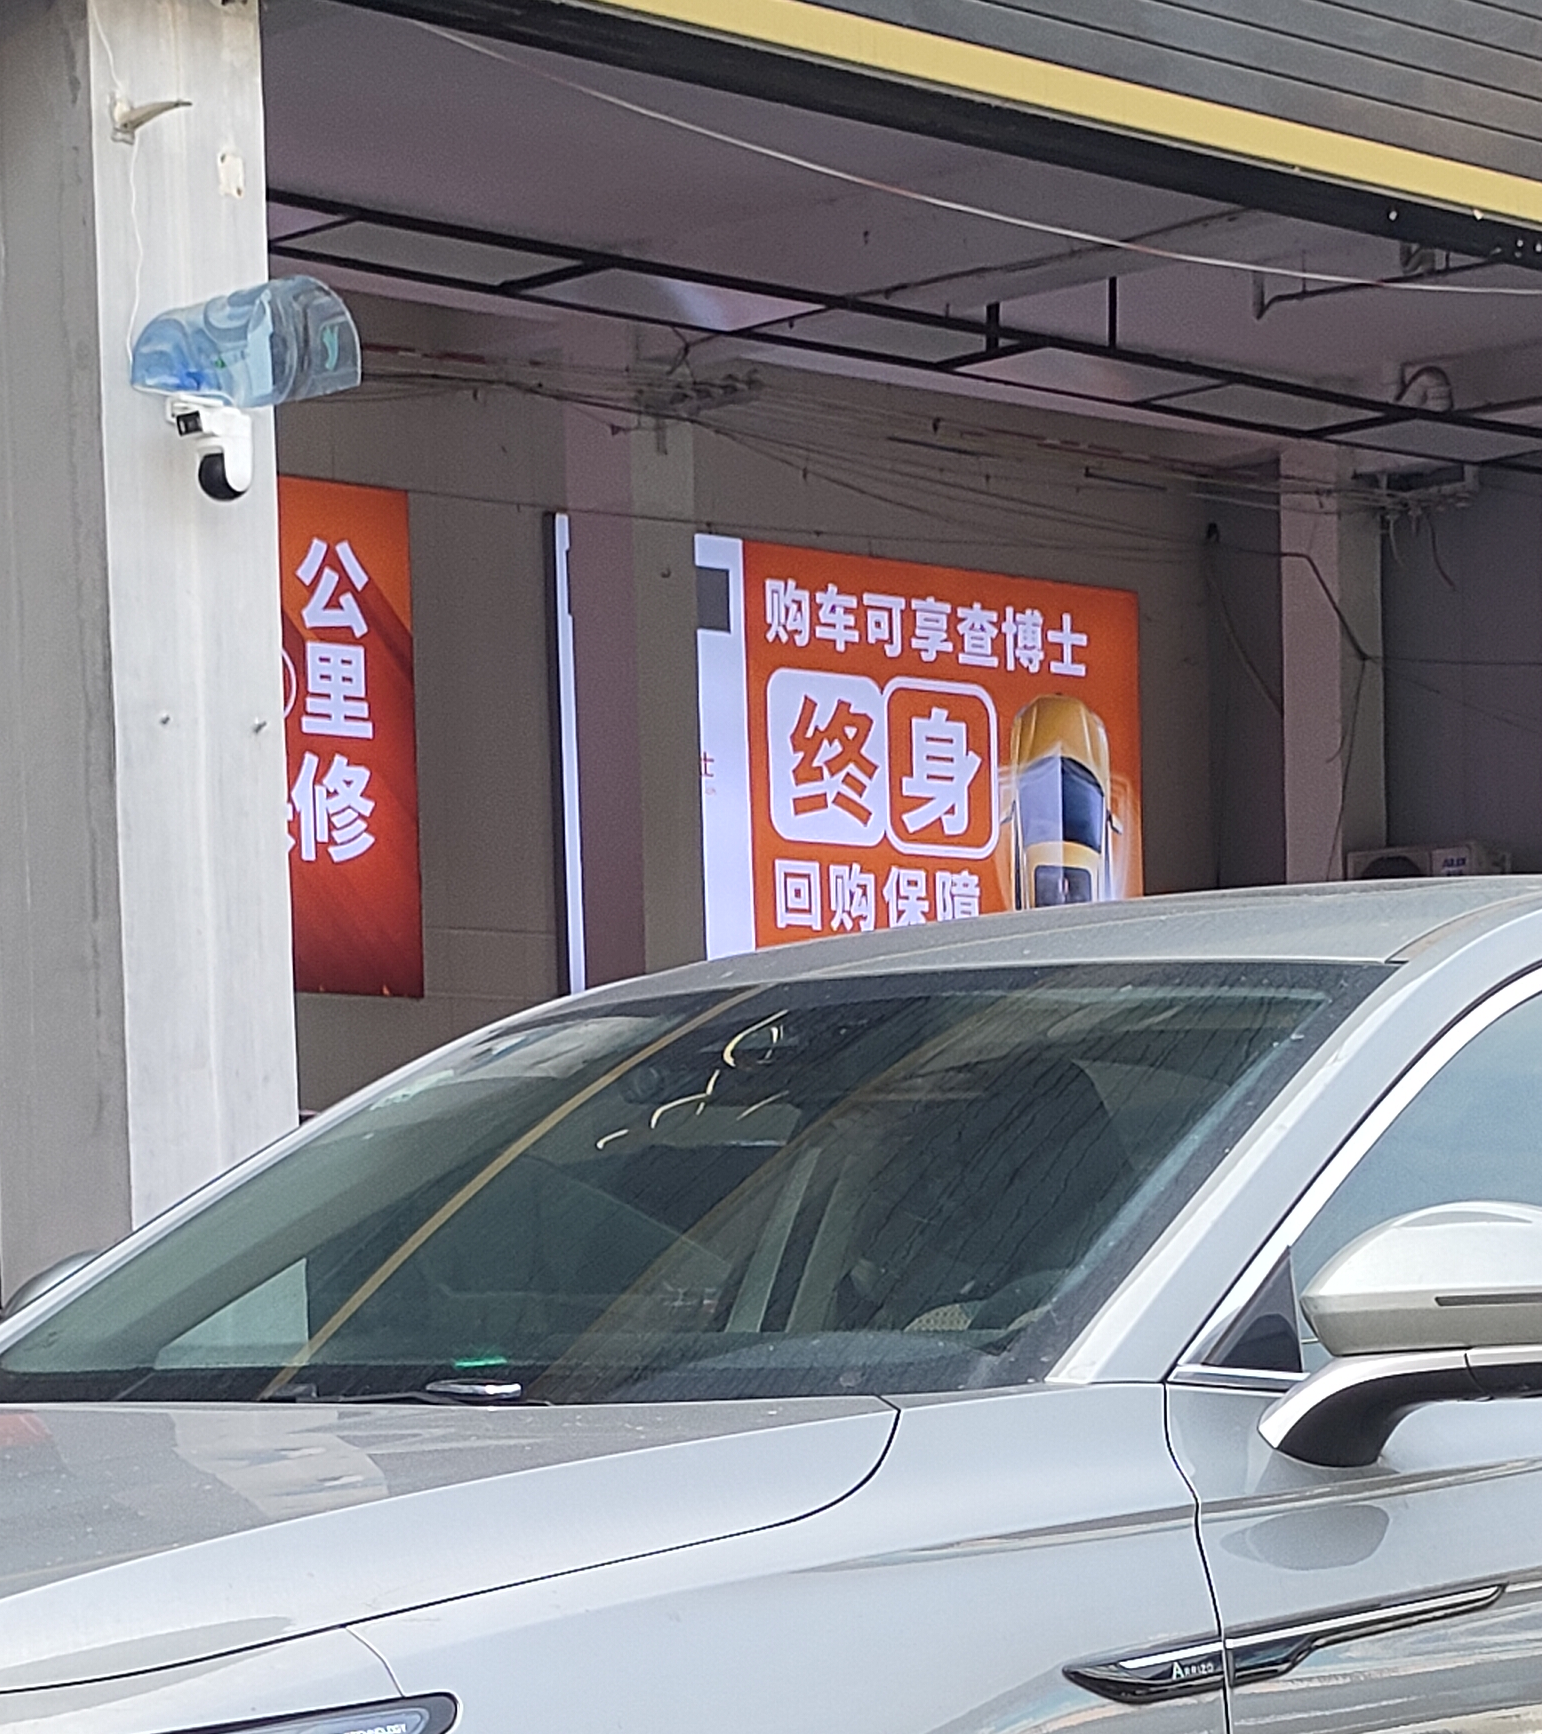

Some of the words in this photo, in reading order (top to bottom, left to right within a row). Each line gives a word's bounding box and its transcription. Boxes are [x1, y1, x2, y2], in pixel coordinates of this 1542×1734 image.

[764, 577, 1088, 677] 购车可享查博士
[286, 751, 376, 864] 修
[789, 694, 982, 836] 终身
[774, 859, 982, 933] 回购保障
